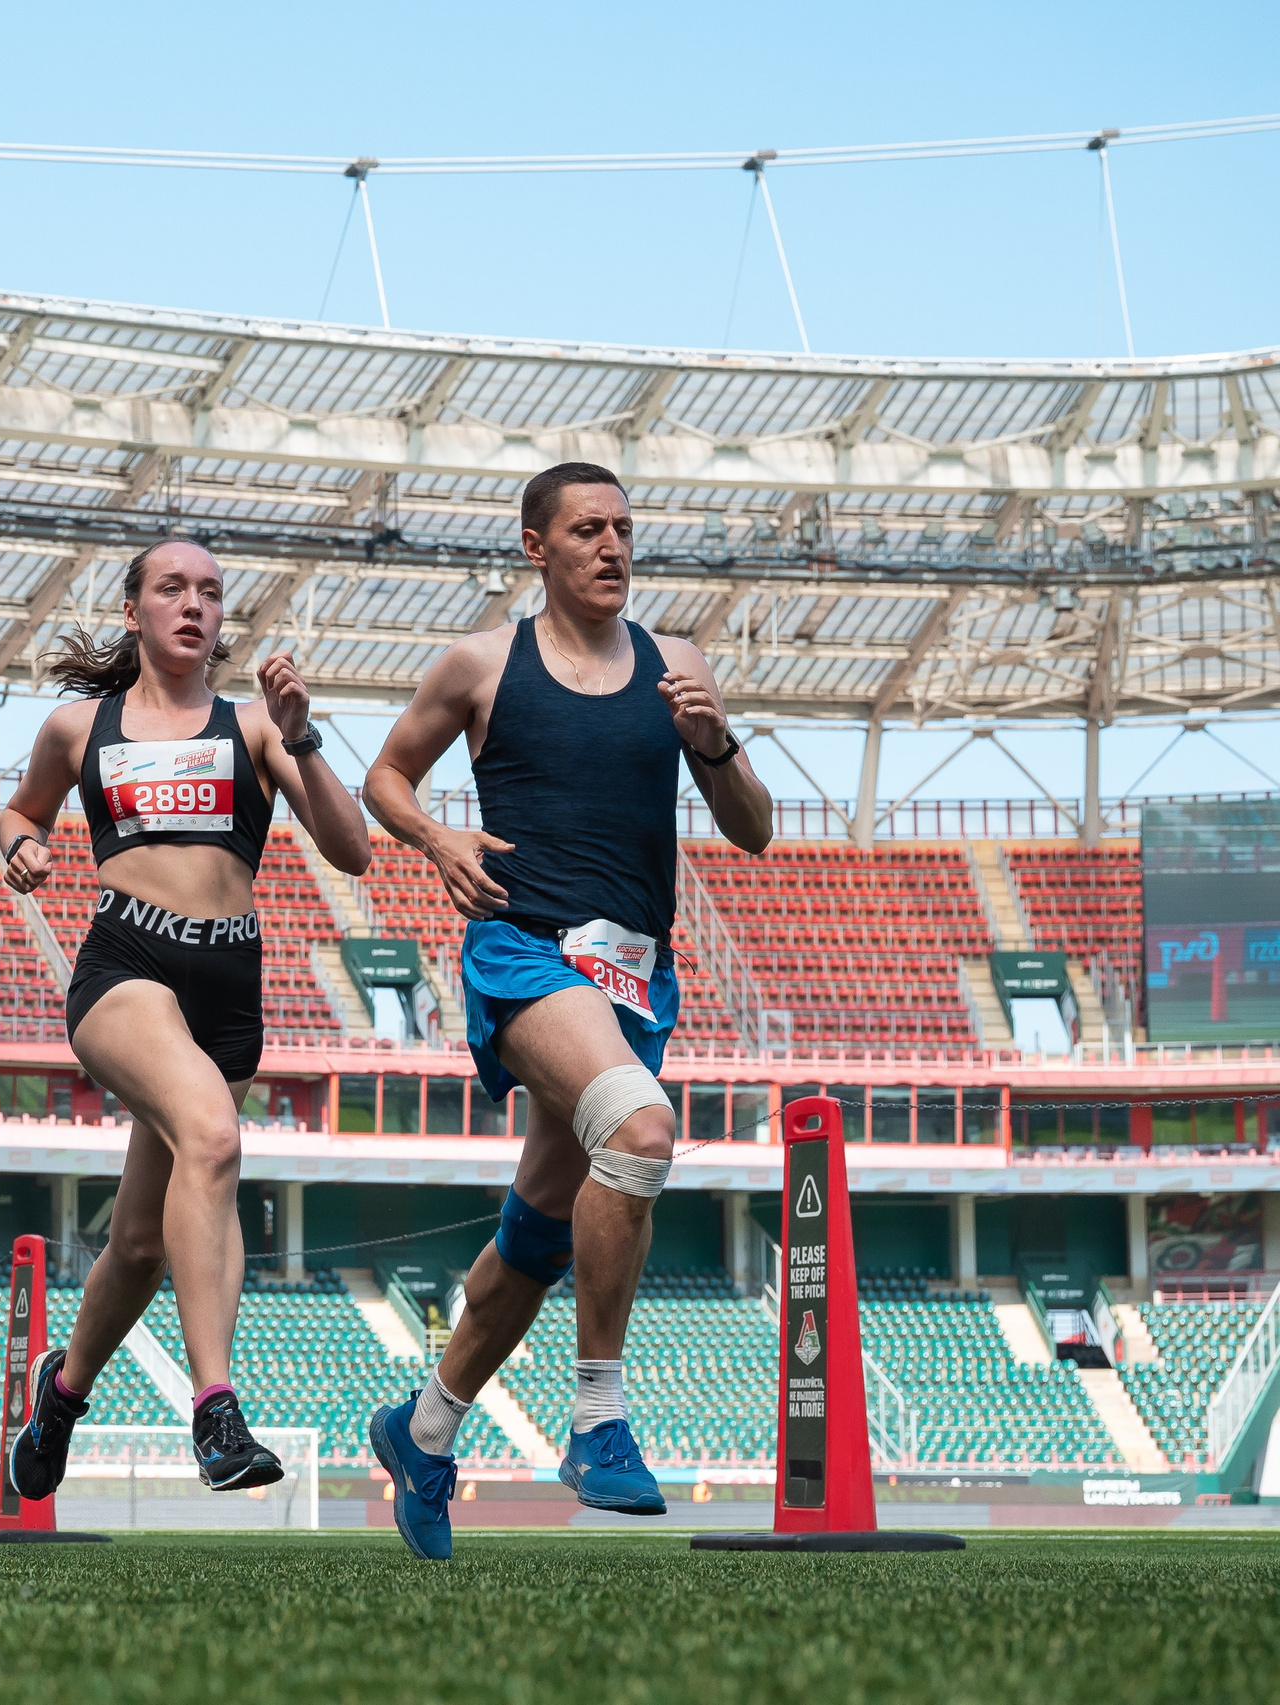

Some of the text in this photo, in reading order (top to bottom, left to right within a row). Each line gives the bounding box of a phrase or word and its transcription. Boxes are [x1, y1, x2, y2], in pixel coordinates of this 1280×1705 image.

[134, 783, 216, 812] 2899
[120, 896, 206, 945] NIKE
[209, 911, 258, 945] PRO
[593, 961, 640, 1004] 2138
[790, 1245, 826, 1265] PLEASE
[790, 1266, 826, 1283] KEEP OFF
[790, 1284, 826, 1299] THE PITCH
[789, 1390, 797, 1401] НЕ
[789, 1402, 825, 1418] НА ПОЛЕ!
